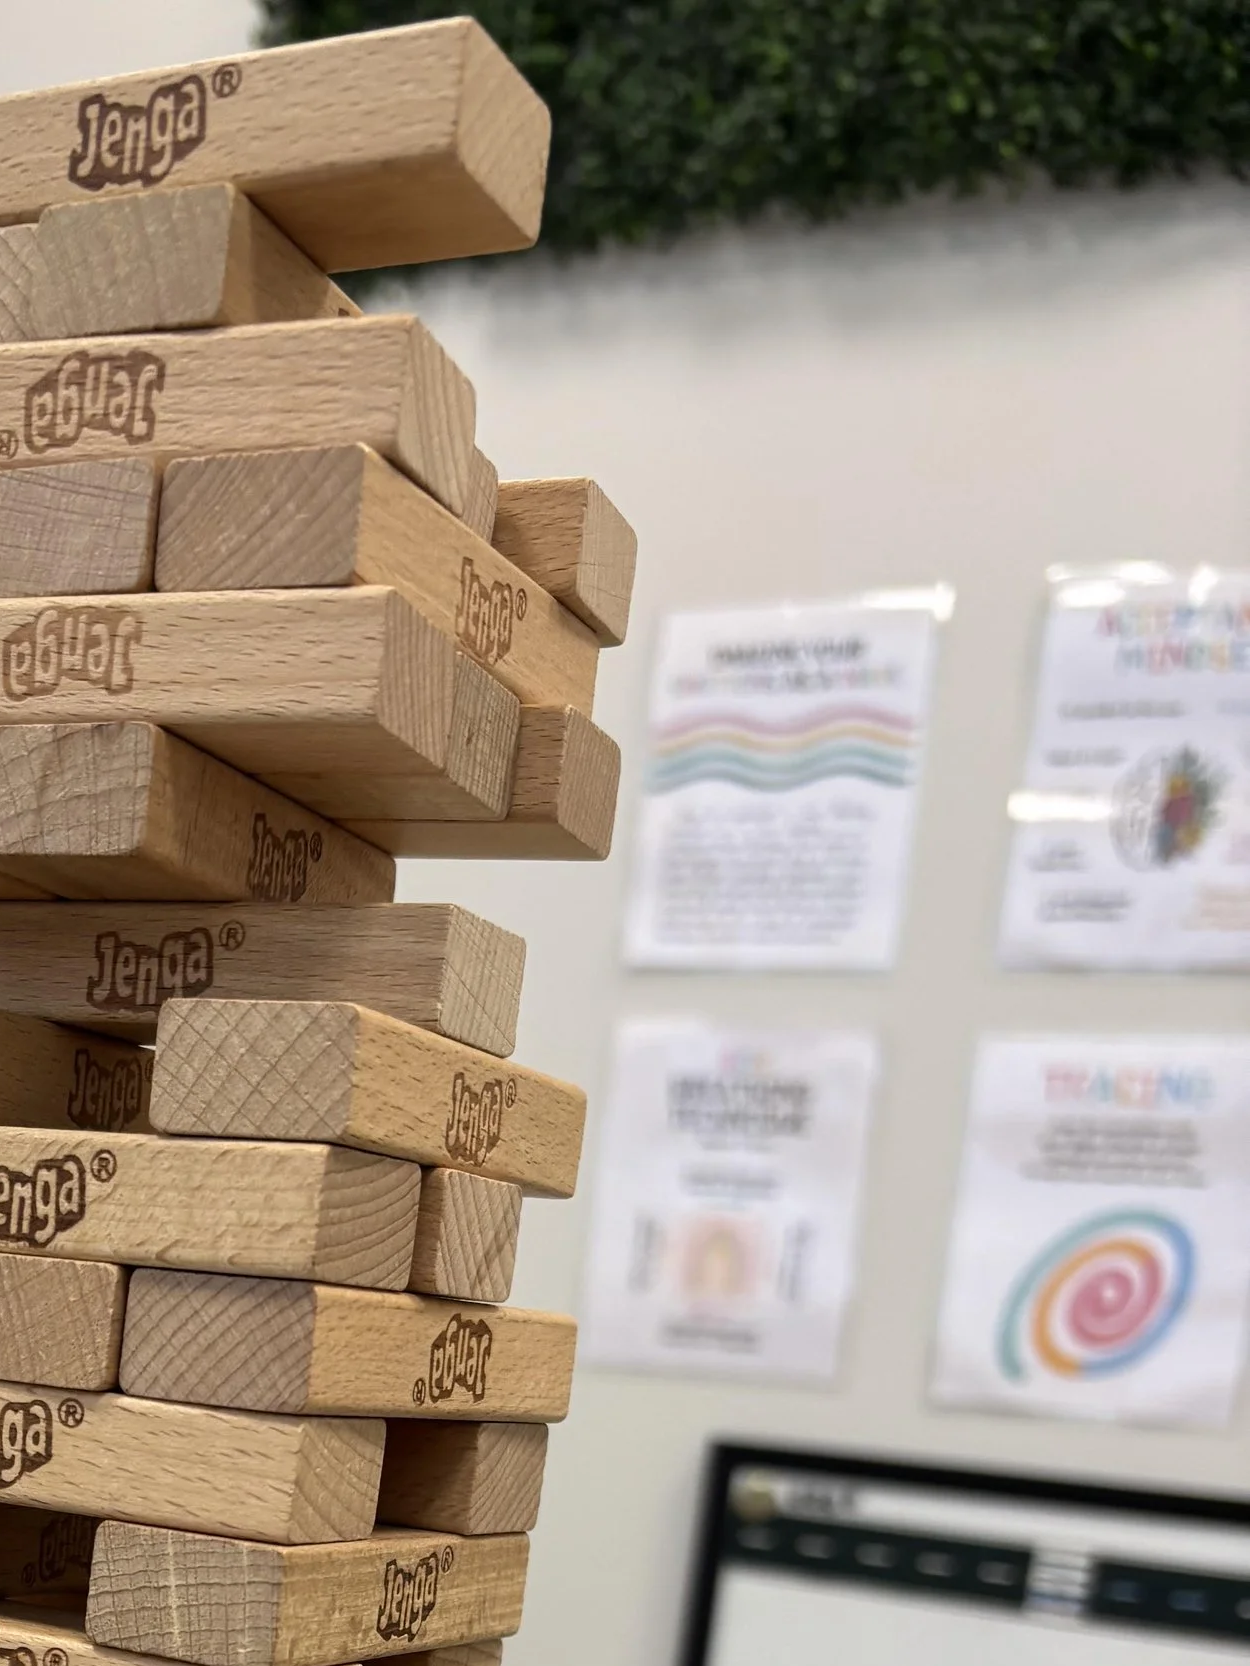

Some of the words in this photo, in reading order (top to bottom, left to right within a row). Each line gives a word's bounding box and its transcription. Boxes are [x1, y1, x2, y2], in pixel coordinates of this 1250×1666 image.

[67, 74, 206, 191] Jenga
[24, 350, 166, 454] Jenga
[2, 605, 143, 701] Jenga
[455, 556, 513, 664] Jenga
[247, 812, 309, 902] Jenga
[67, 1048, 142, 1132] Jenga
[445, 1071, 503, 1166] Jenga
[429, 1313, 492, 1404] Jenga
[376, 1551, 440, 1642] Jenga
